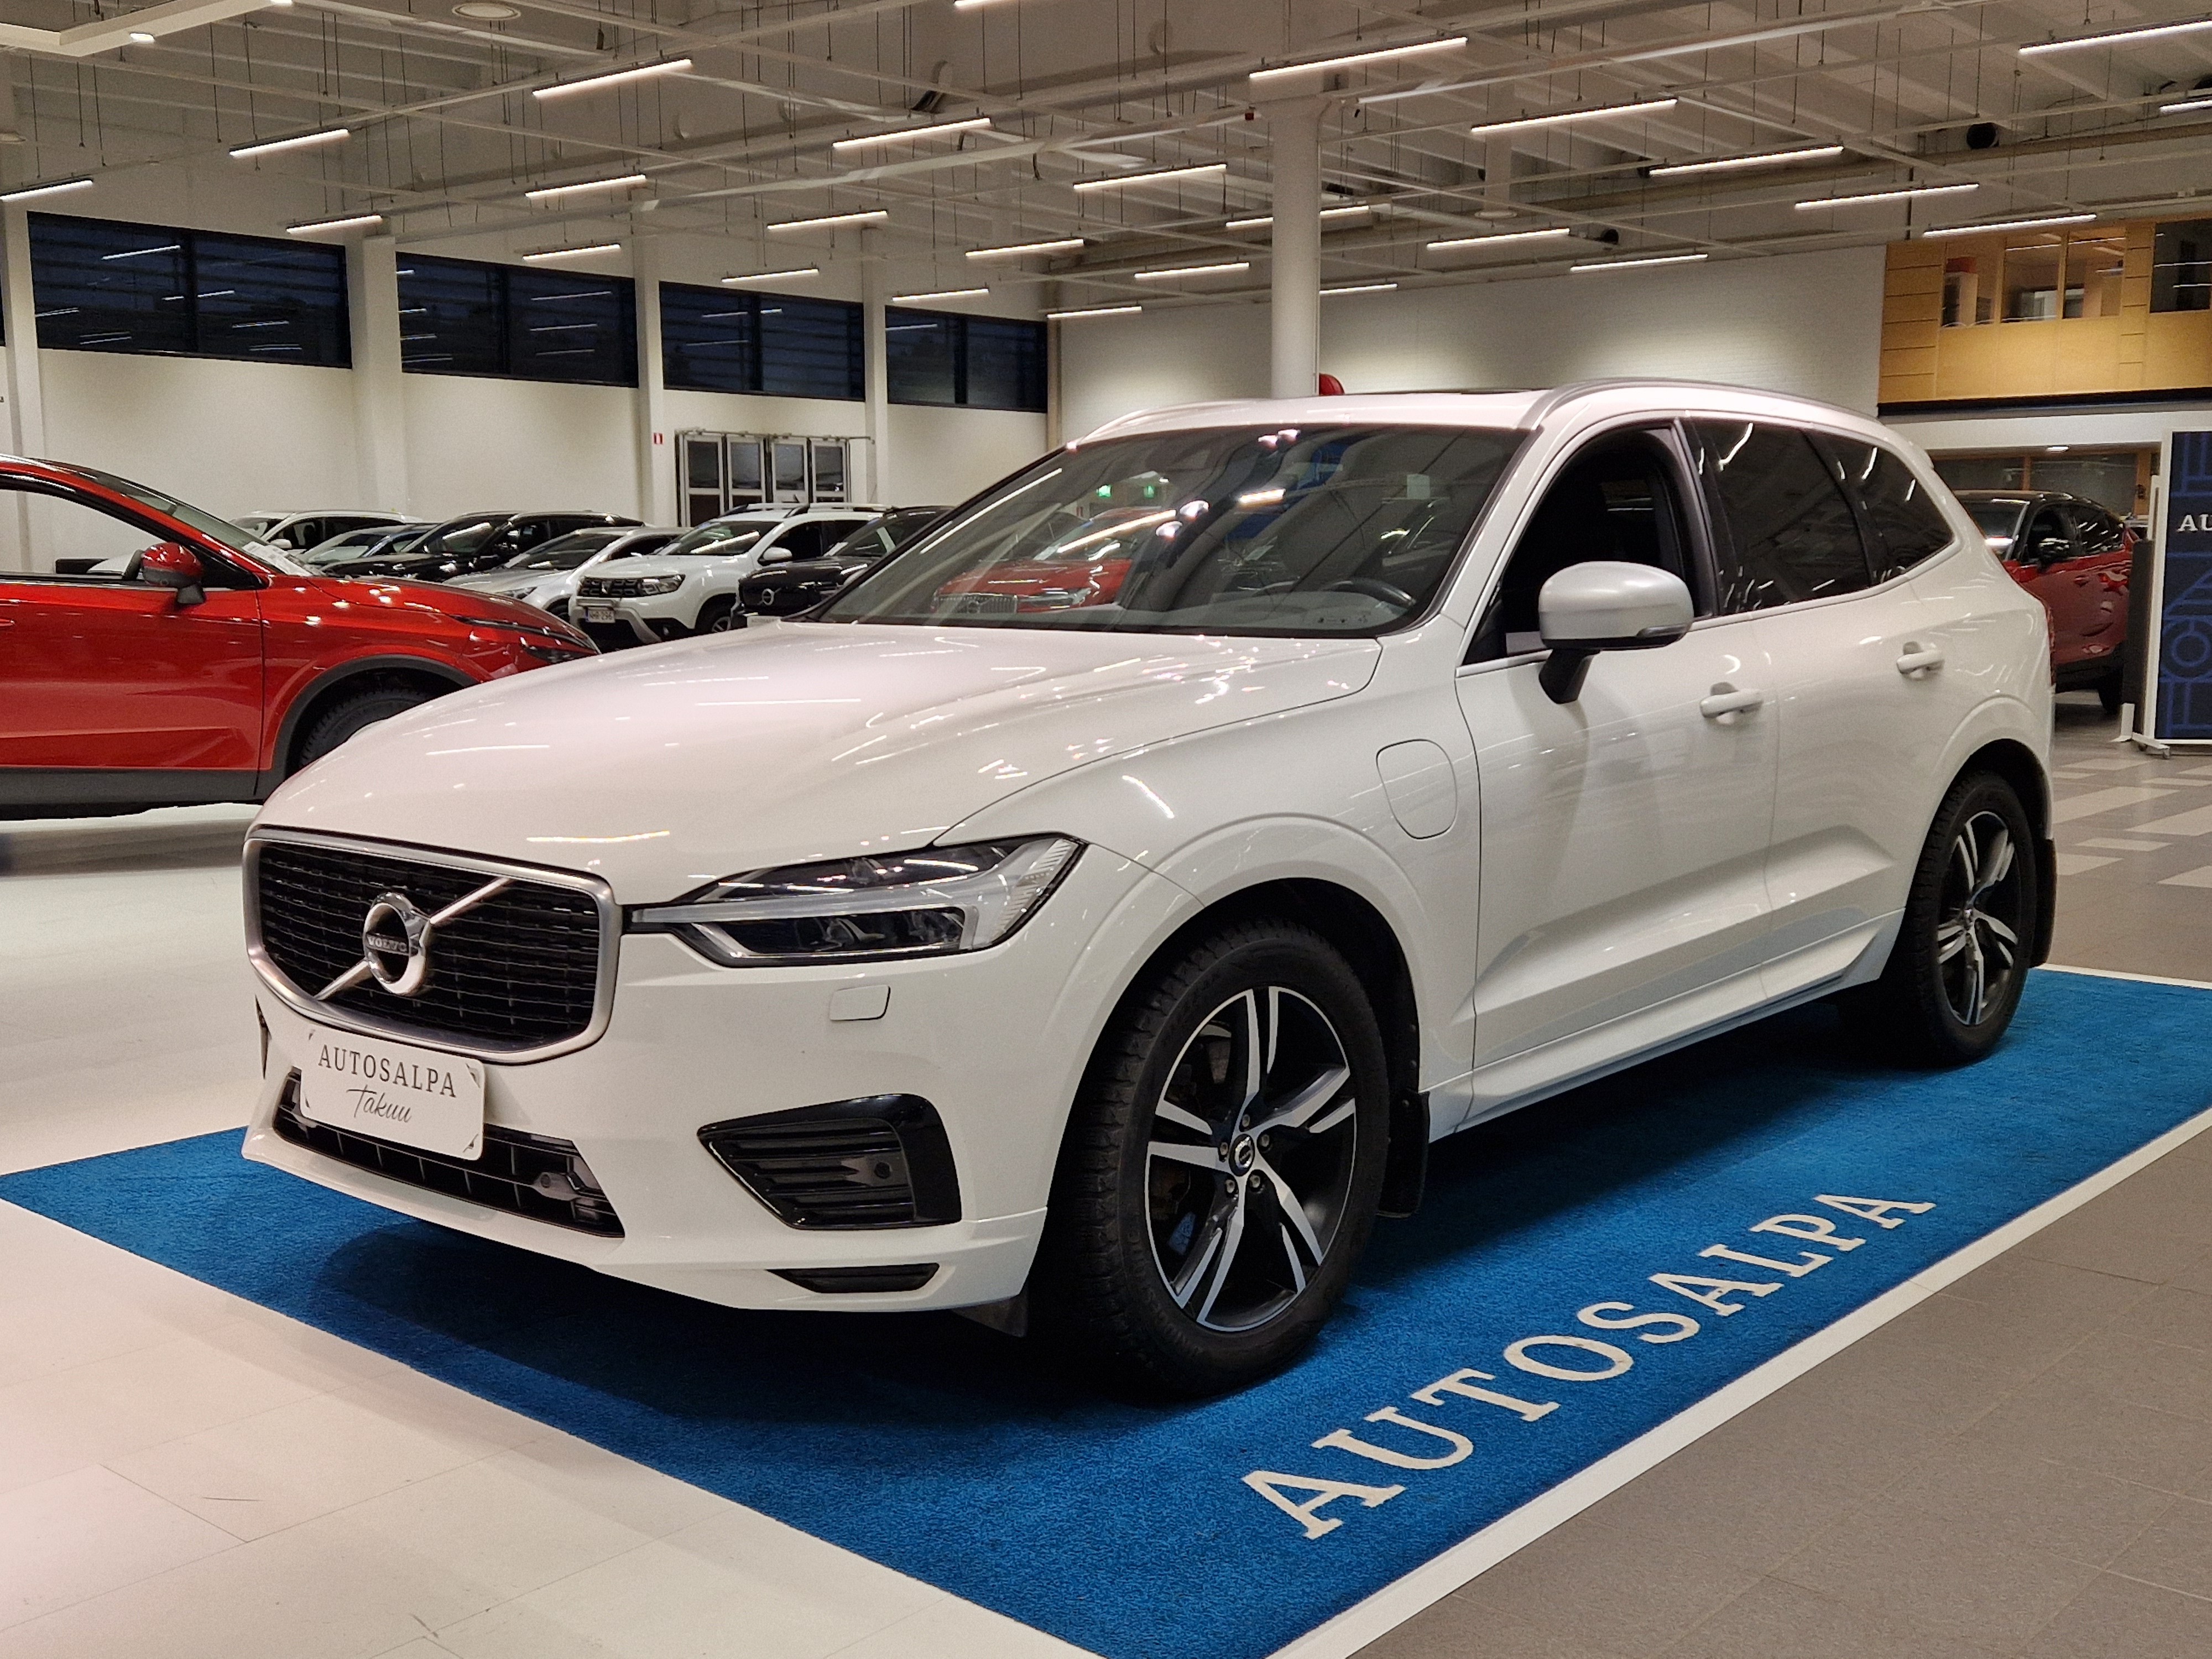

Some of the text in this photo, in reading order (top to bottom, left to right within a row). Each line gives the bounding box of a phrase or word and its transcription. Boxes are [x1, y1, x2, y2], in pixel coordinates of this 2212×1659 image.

[366, 934, 408, 952] VOLVO
[317, 1044, 457, 1098] AUTOSALPA
[346, 1084, 412, 1123] Takuu
[1241, 1194, 1937, 1540] AUTOSALPA
